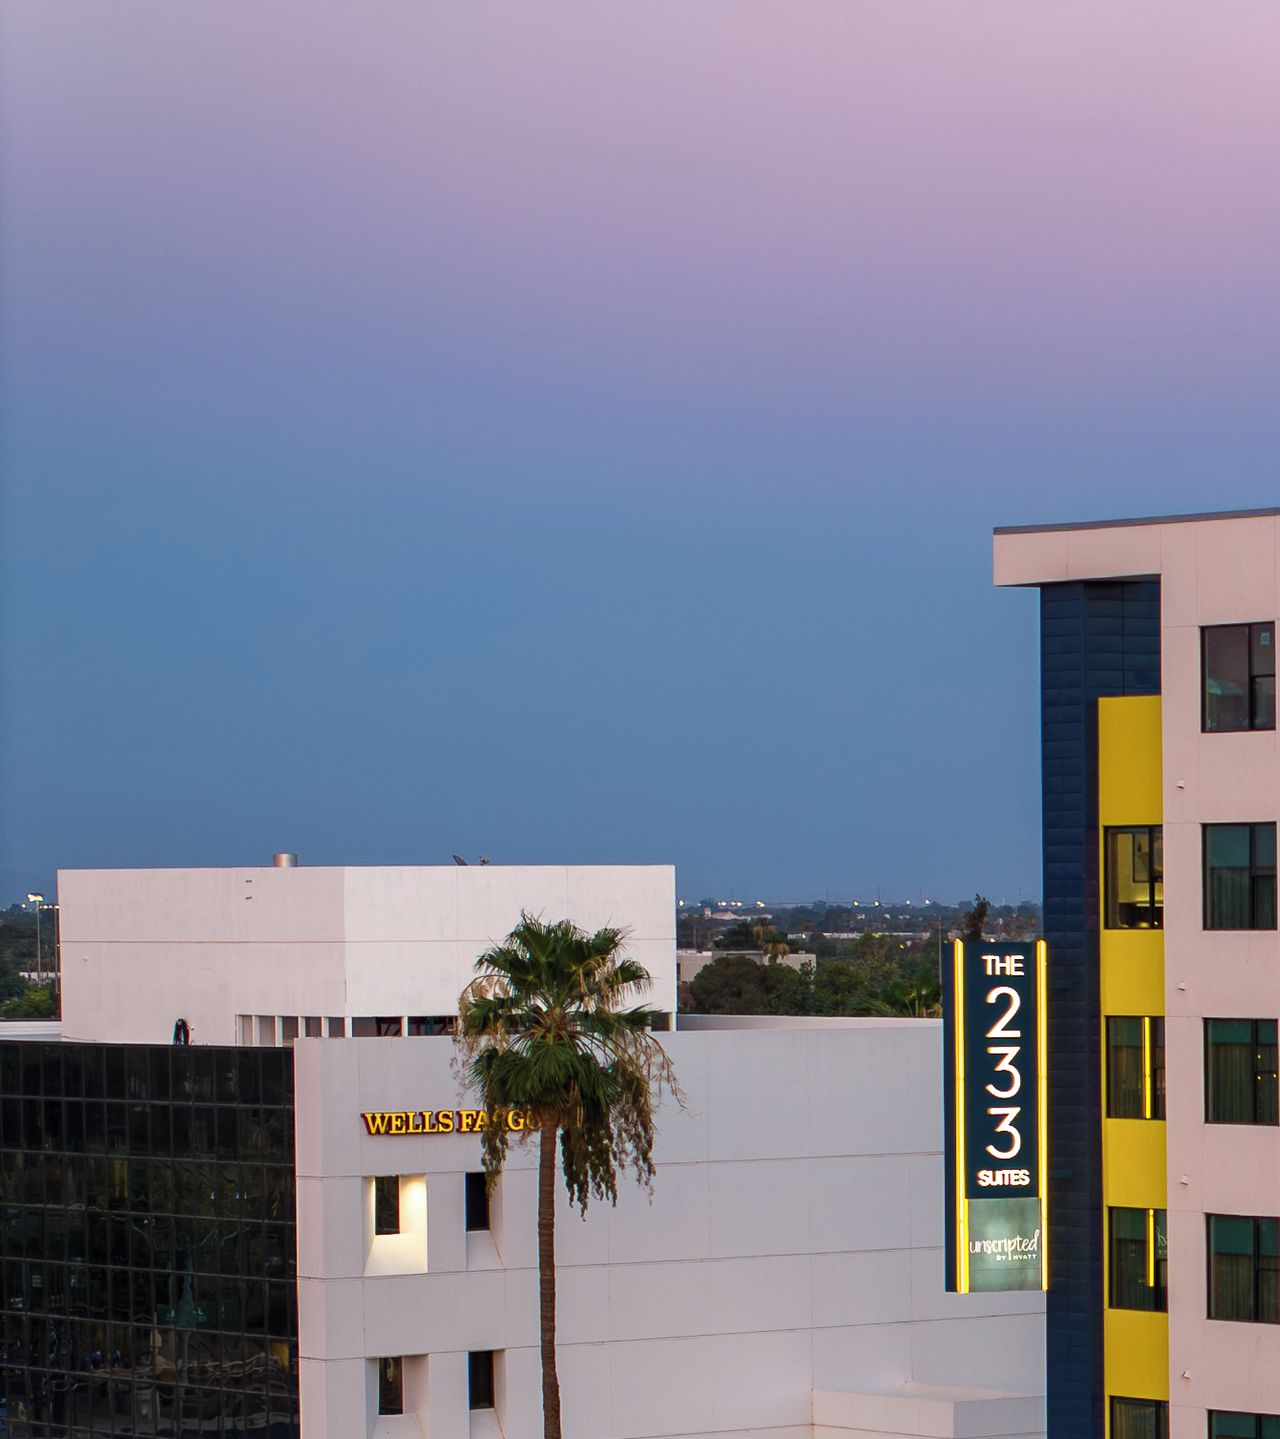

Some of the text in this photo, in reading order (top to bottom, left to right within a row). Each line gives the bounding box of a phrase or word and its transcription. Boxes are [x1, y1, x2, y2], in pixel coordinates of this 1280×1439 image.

[981, 954, 1025, 976] THE
[362, 1111, 455, 1135] WELLS
[977, 1170, 1031, 1187] SUITES
[970, 1229, 1040, 1261] unscripted
